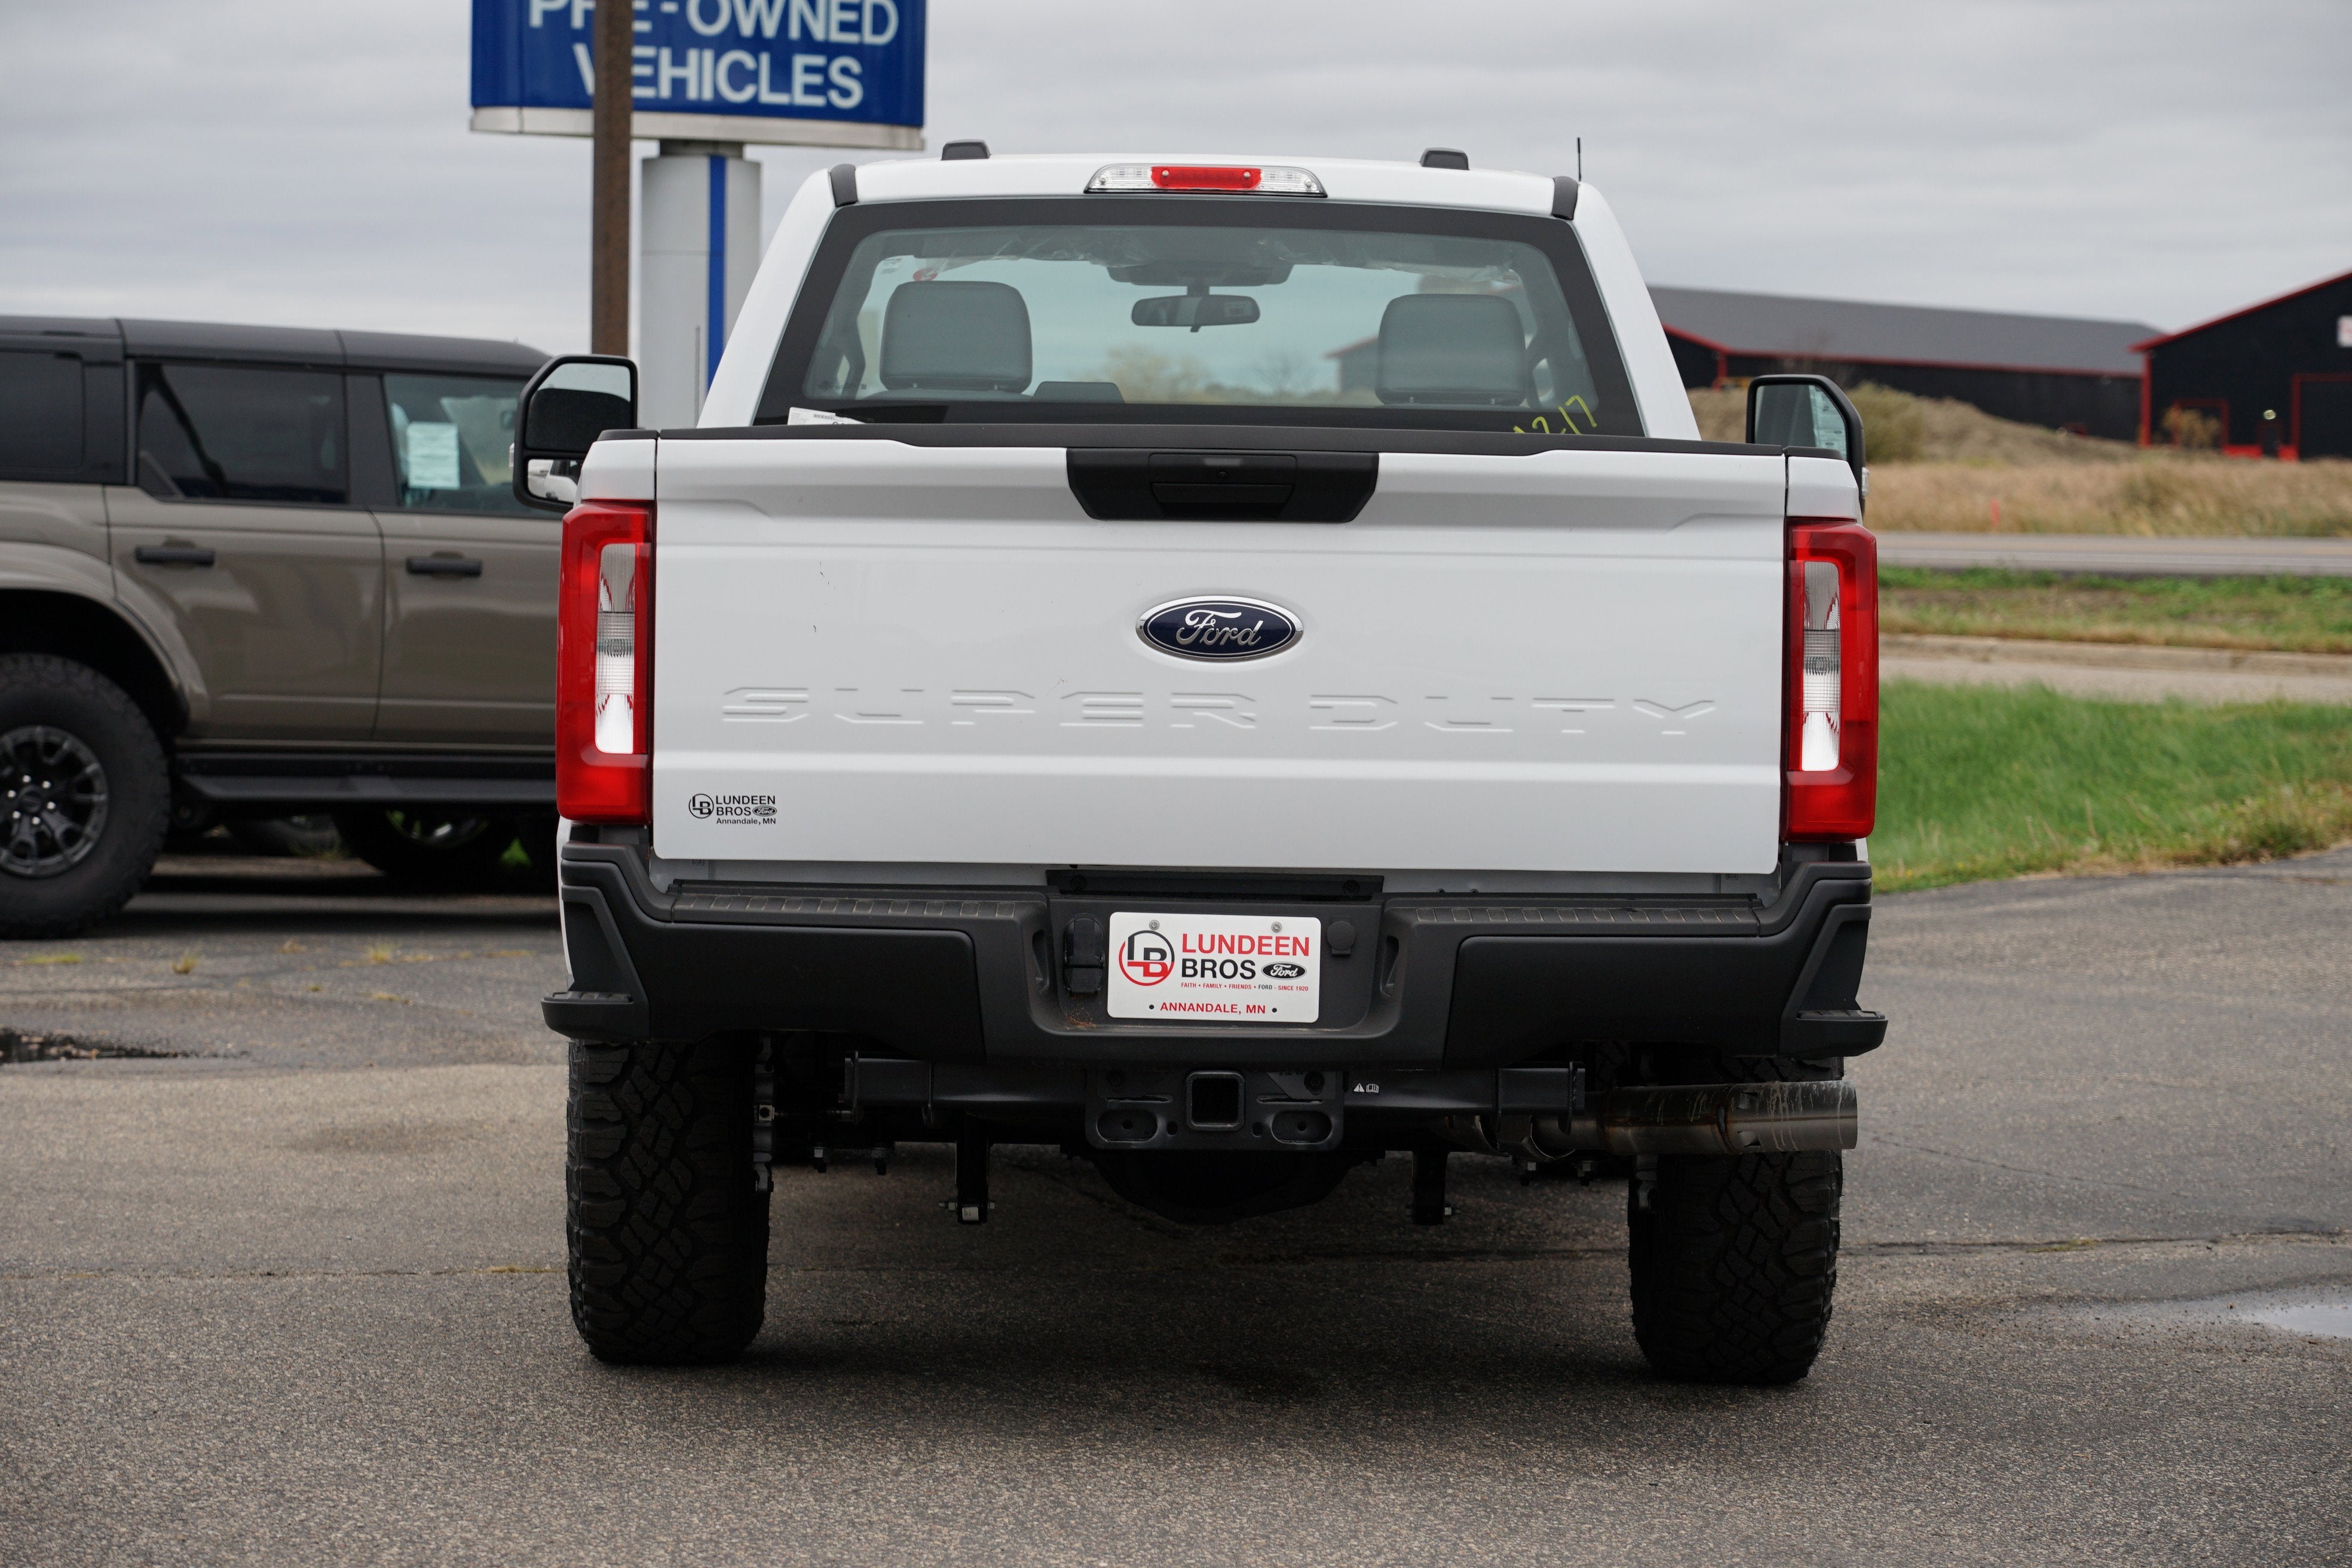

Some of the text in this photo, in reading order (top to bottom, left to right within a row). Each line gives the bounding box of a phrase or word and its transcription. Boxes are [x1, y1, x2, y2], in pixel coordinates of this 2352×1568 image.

[1175, 609, 1264, 646] Ford
[723, 687, 1716, 735] SUPER DUTY
[715, 795, 776, 805] LUNDEEN
[716, 806, 751, 816] BROS
[1182, 933, 1309, 956] LUNDEEN
[1181, 958, 1298, 980] BROS Ford
[1160, 1002, 1266, 1015] ANNANDALE, MN
